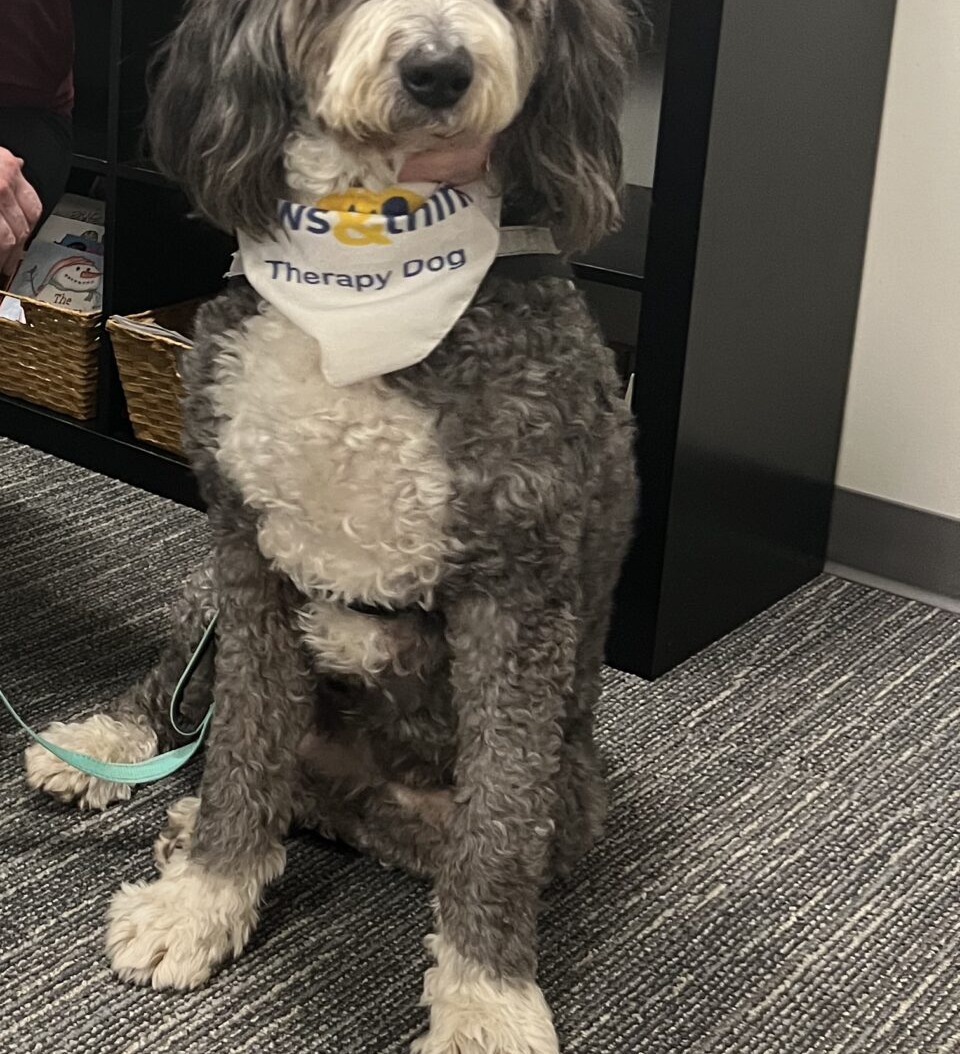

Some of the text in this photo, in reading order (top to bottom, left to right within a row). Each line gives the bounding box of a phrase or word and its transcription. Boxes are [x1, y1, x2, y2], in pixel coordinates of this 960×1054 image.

[264, 248, 467, 292] Therapy Dog
[53, 293, 72, 306] The
